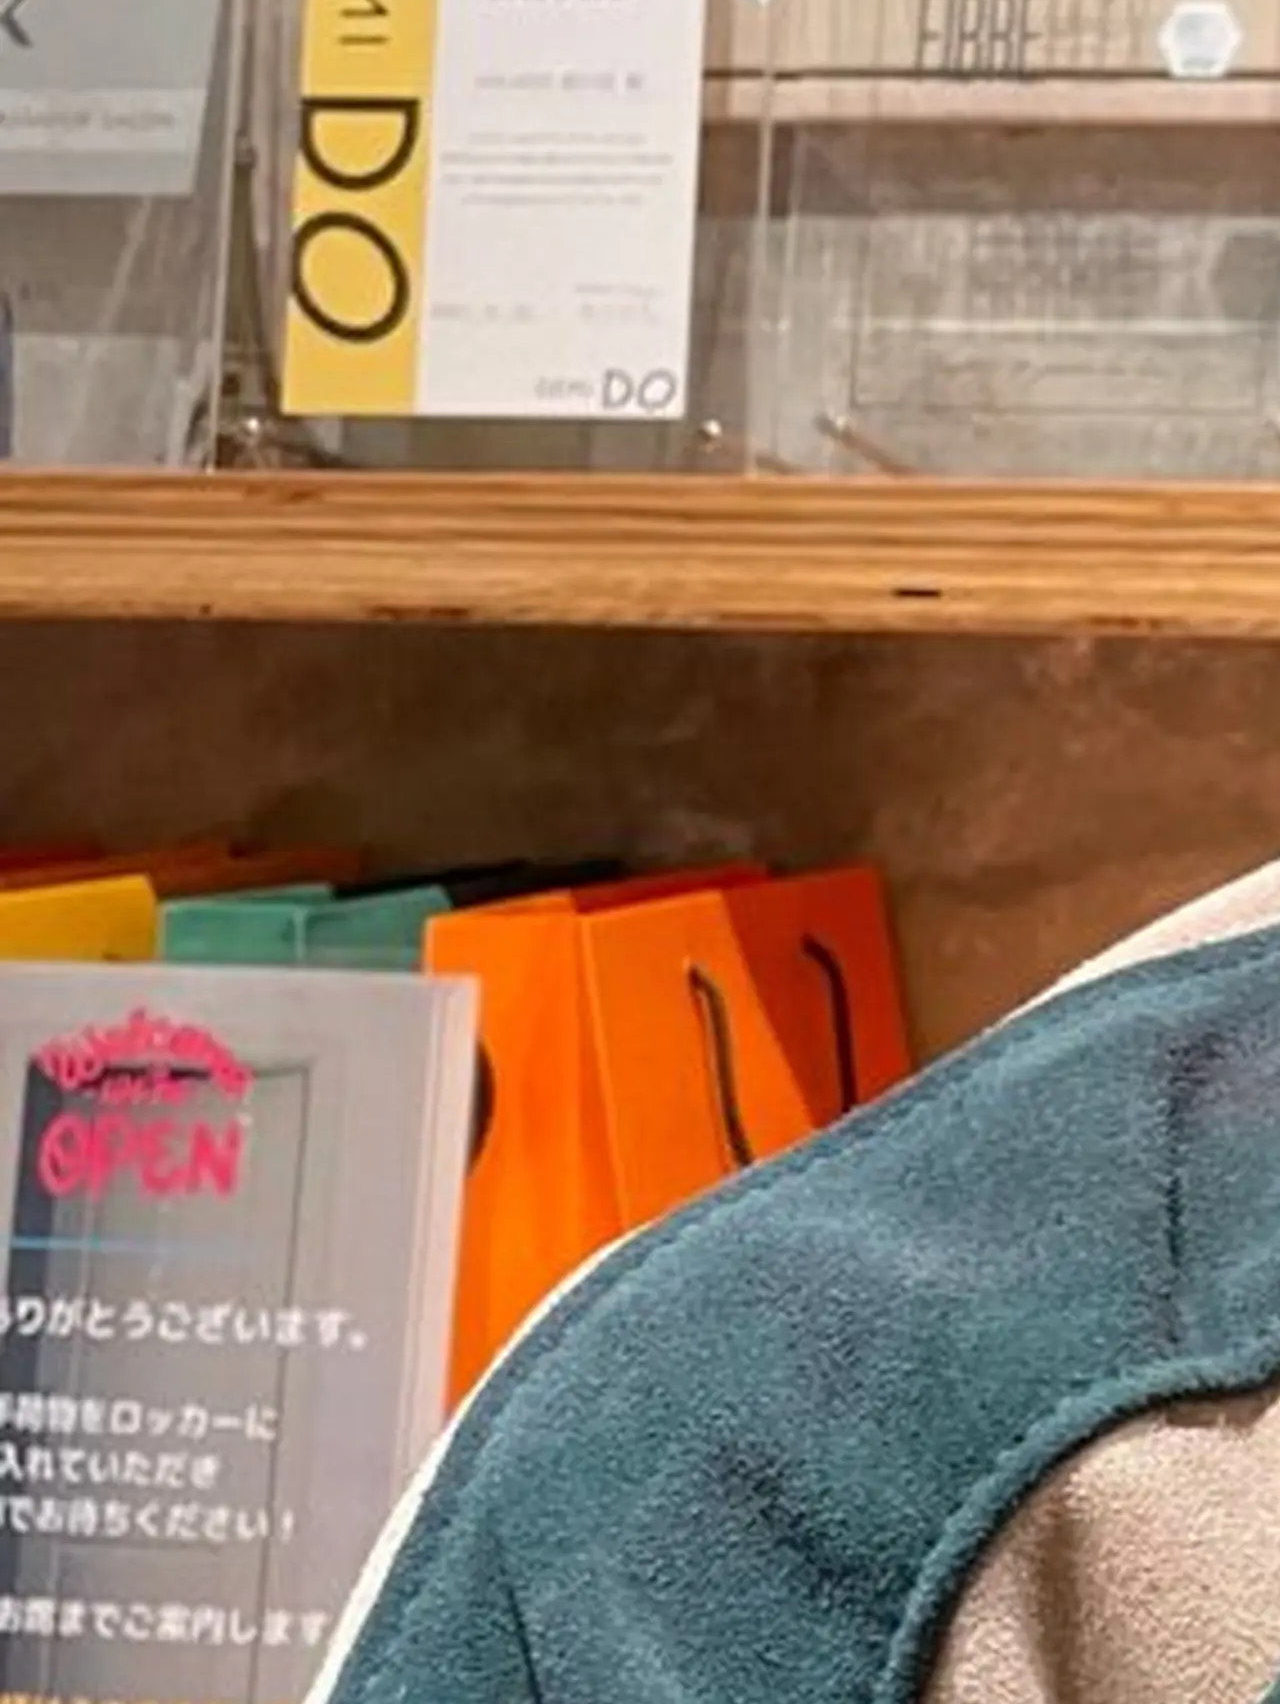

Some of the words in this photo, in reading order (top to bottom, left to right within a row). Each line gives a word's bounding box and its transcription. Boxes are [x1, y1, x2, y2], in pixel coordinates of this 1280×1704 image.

[292, 97, 420, 344] DO
[602, 367, 679, 409] DO
[37, 1110, 244, 1201] OPEN
[0, 1496, 294, 1543] でお待ちください！
